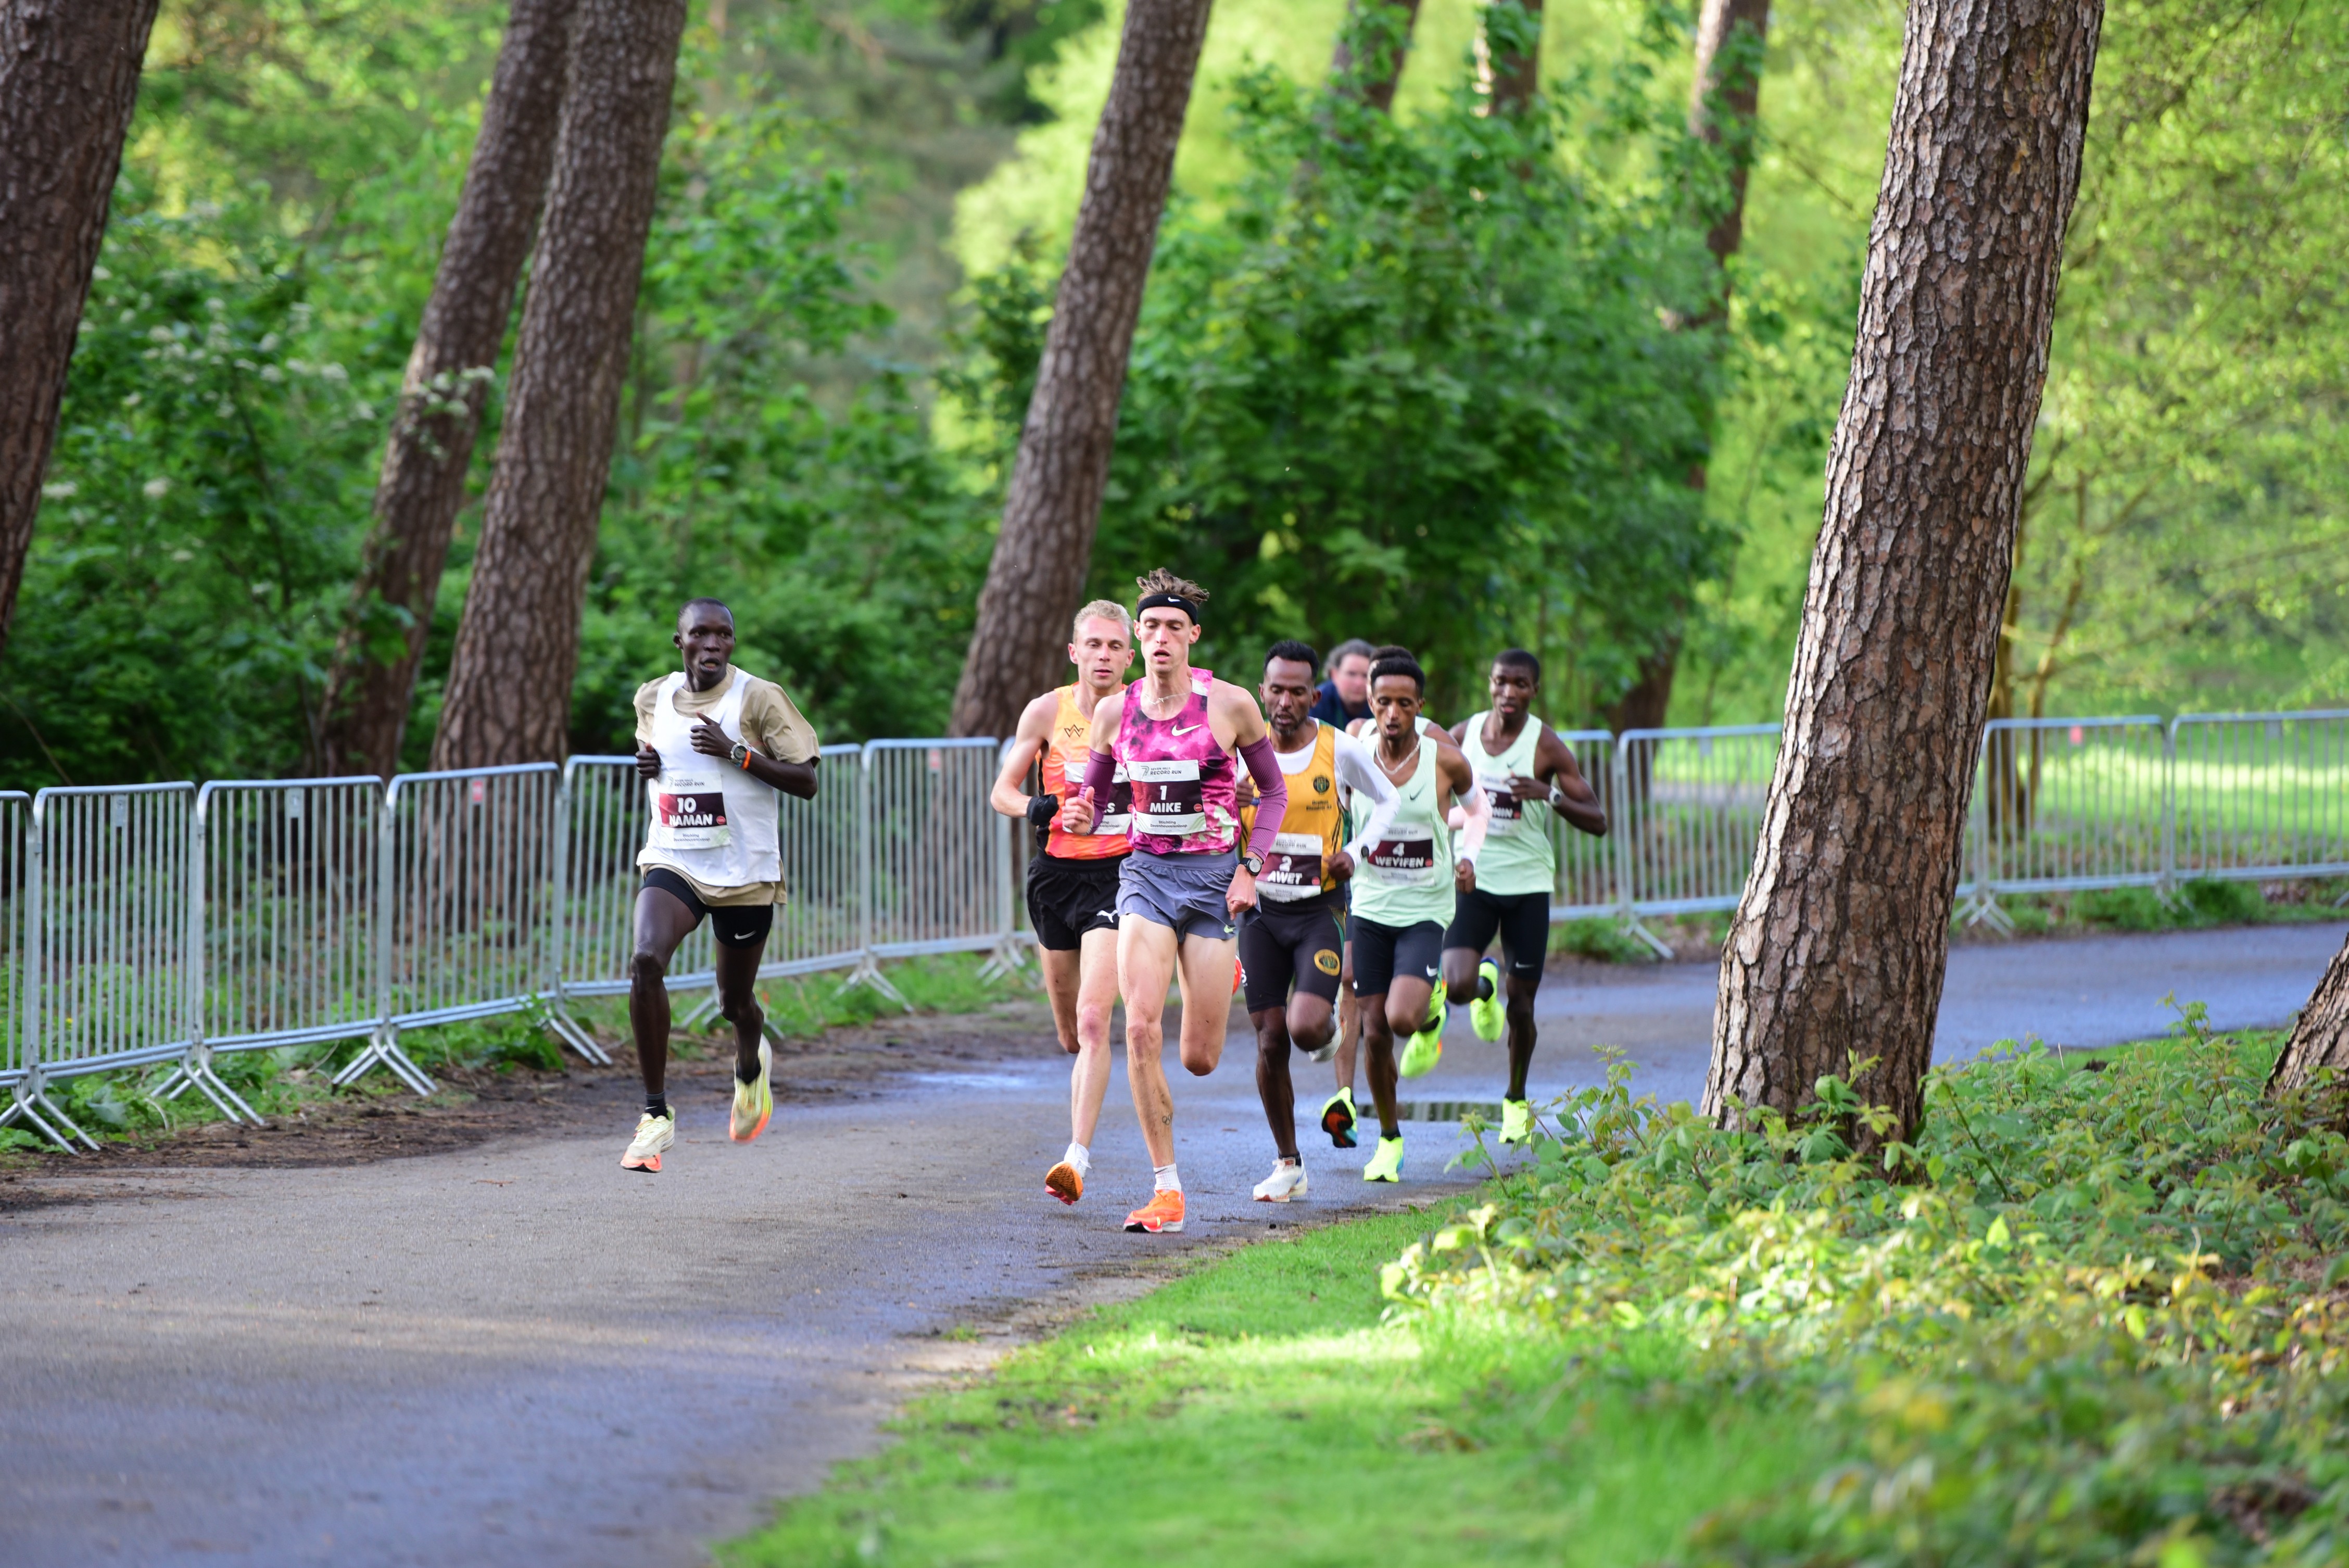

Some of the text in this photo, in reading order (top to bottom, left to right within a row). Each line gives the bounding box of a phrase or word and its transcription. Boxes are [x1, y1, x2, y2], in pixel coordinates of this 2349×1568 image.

[1160, 785, 1167, 800] 1
[677, 797, 697, 813] 10
[1150, 802, 1182, 813] MIKE
[668, 814, 713, 827] NAMAN
[1393, 842, 1405, 857] 4
[1279, 855, 1292, 872] 2
[1267, 870, 1303, 885] AWET
